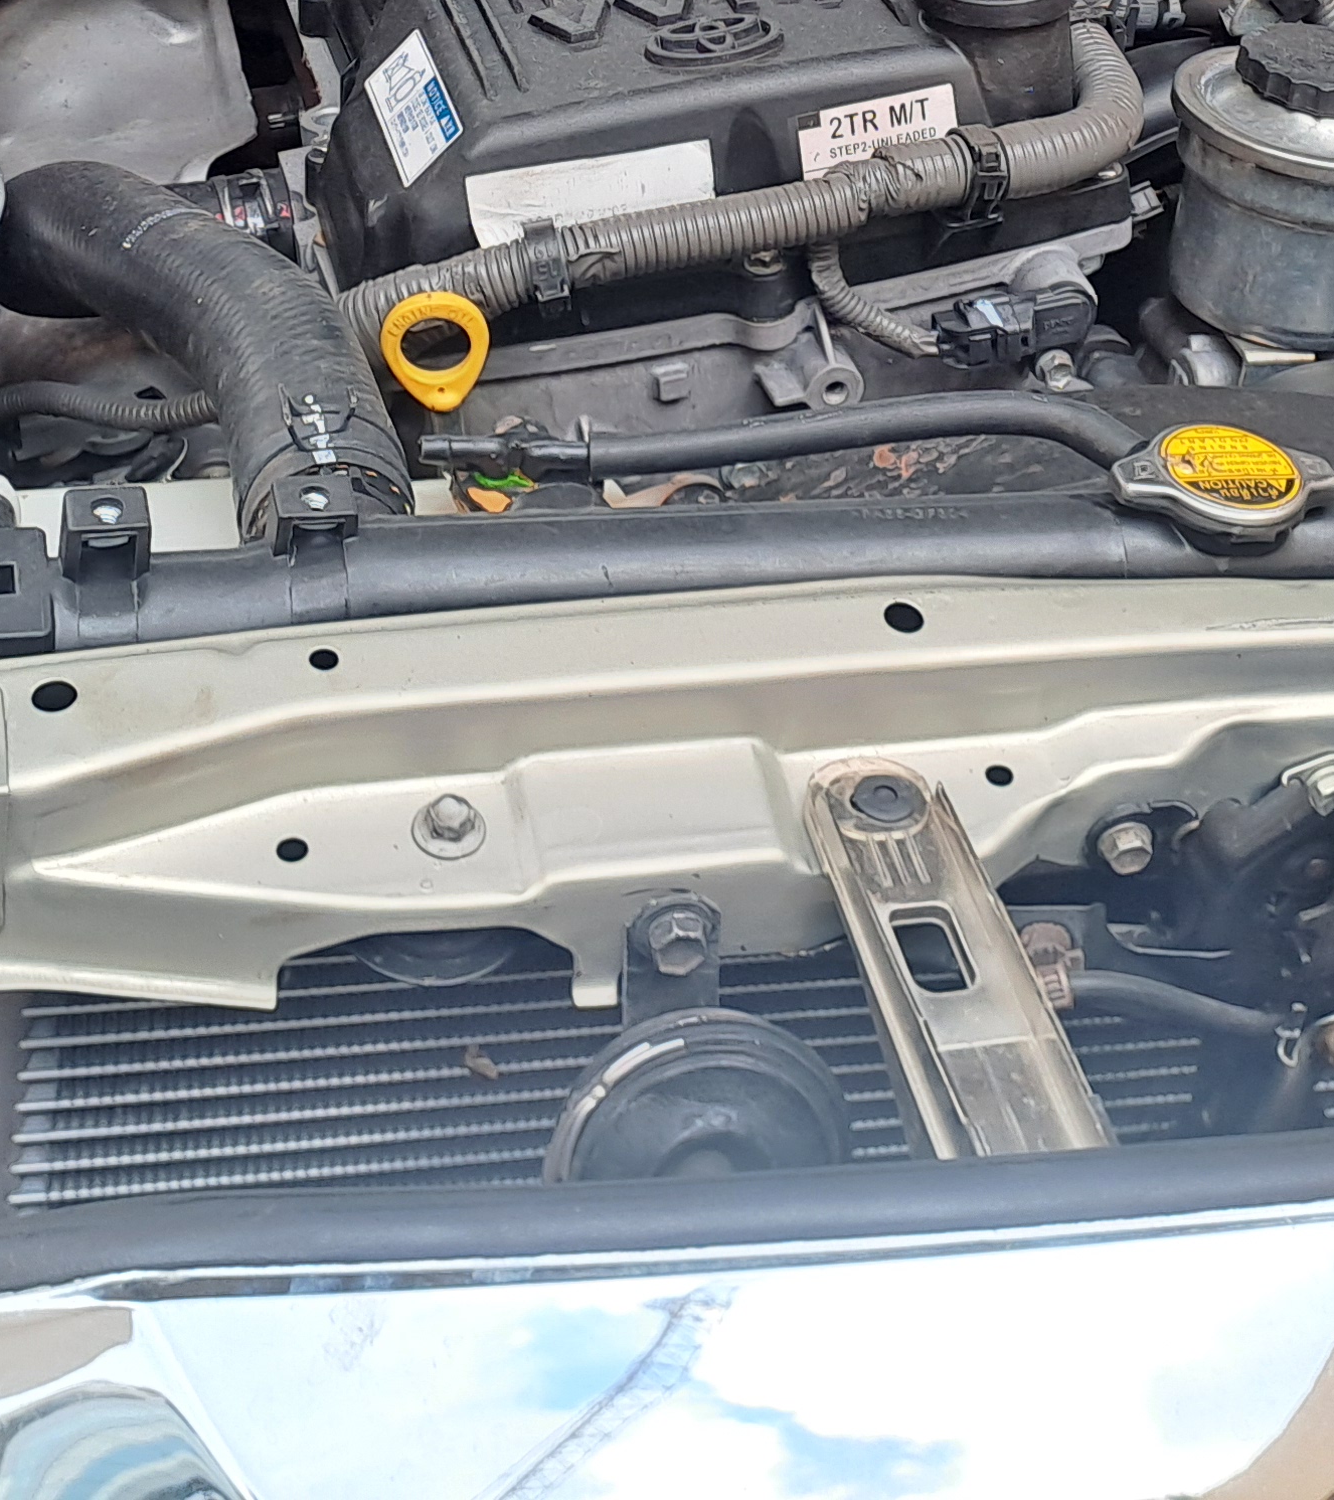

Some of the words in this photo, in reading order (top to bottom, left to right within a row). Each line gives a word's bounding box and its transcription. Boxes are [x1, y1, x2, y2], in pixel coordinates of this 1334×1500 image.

[425, 80, 445, 117] NOTICE
[829, 109, 879, 139] 2TR
[889, 98, 929, 128] M/T
[829, 126, 937, 160] STEP2-UNLEADED
[1199, 478, 1268, 490] CAUTION
